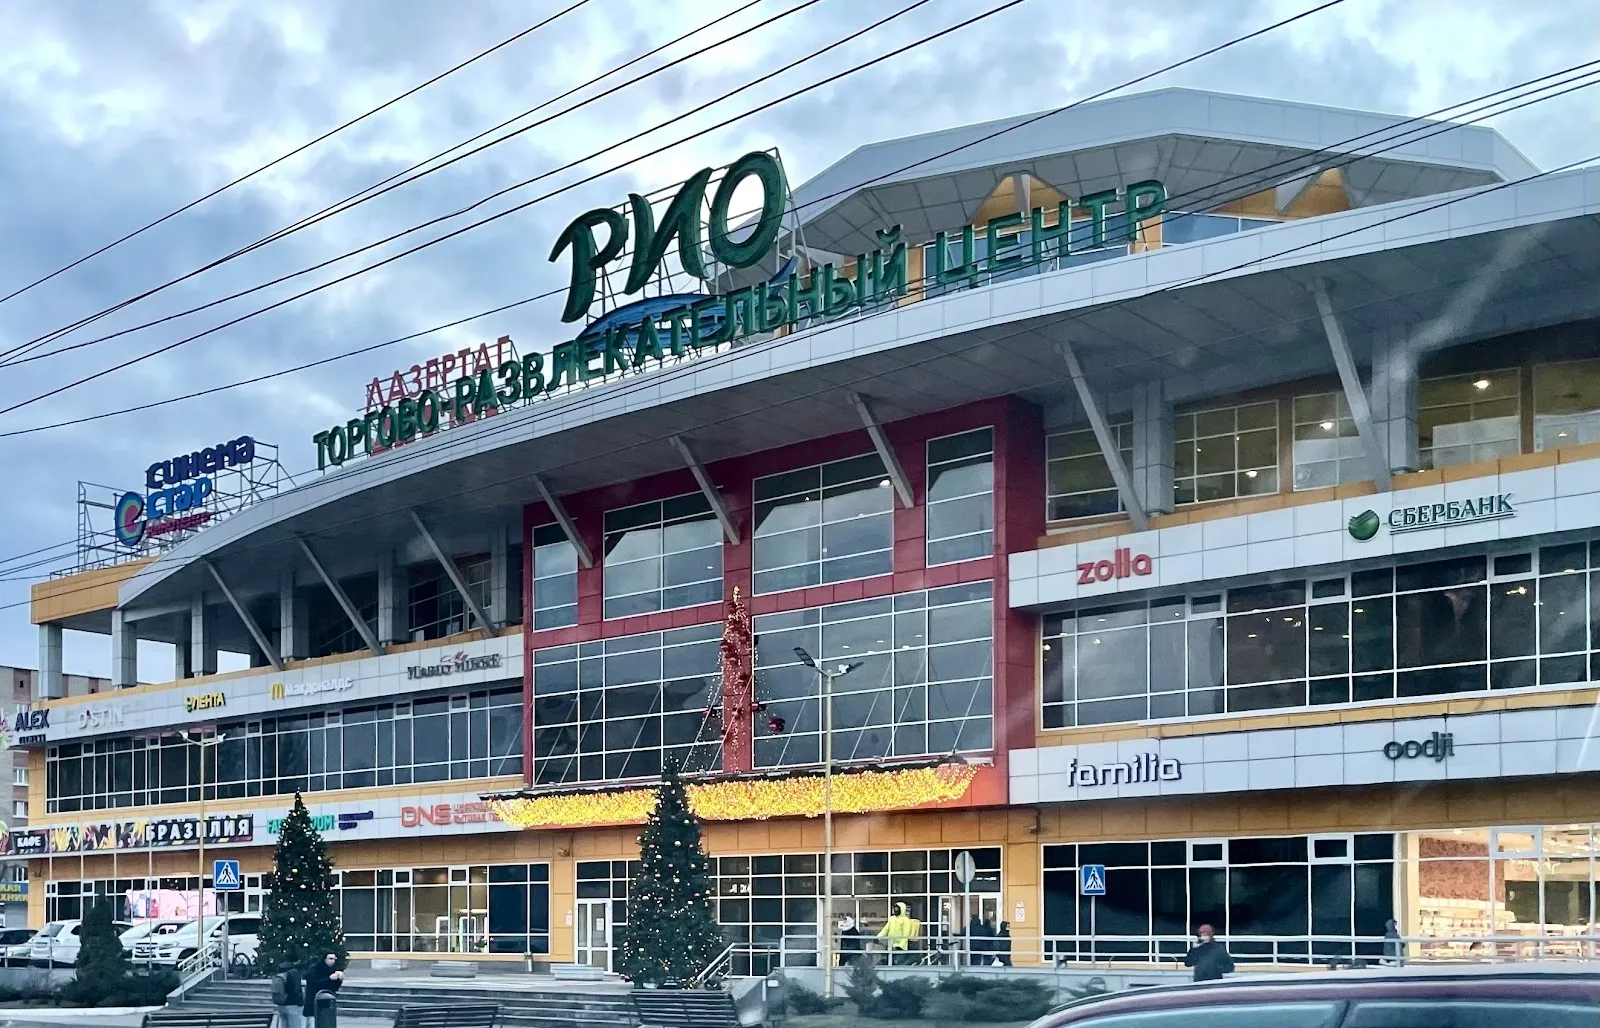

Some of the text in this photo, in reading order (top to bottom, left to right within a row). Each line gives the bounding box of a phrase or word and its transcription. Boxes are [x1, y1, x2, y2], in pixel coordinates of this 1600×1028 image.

[548, 151, 787, 323] РИО
[936, 179, 1166, 289] ЦЕНТР
[366, 335, 510, 412] ЛАЗЕРТАГ
[1388, 492, 1515, 528] СБЕРБАНК
[1076, 548, 1152, 585] zolla
[15, 708, 49, 732] ALEX
[1383, 731, 1455, 763] oodji
[1066, 753, 1183, 787] familia
[145, 819, 250, 841] БРАЗИЛИЯ
[401, 804, 451, 828] DNS
